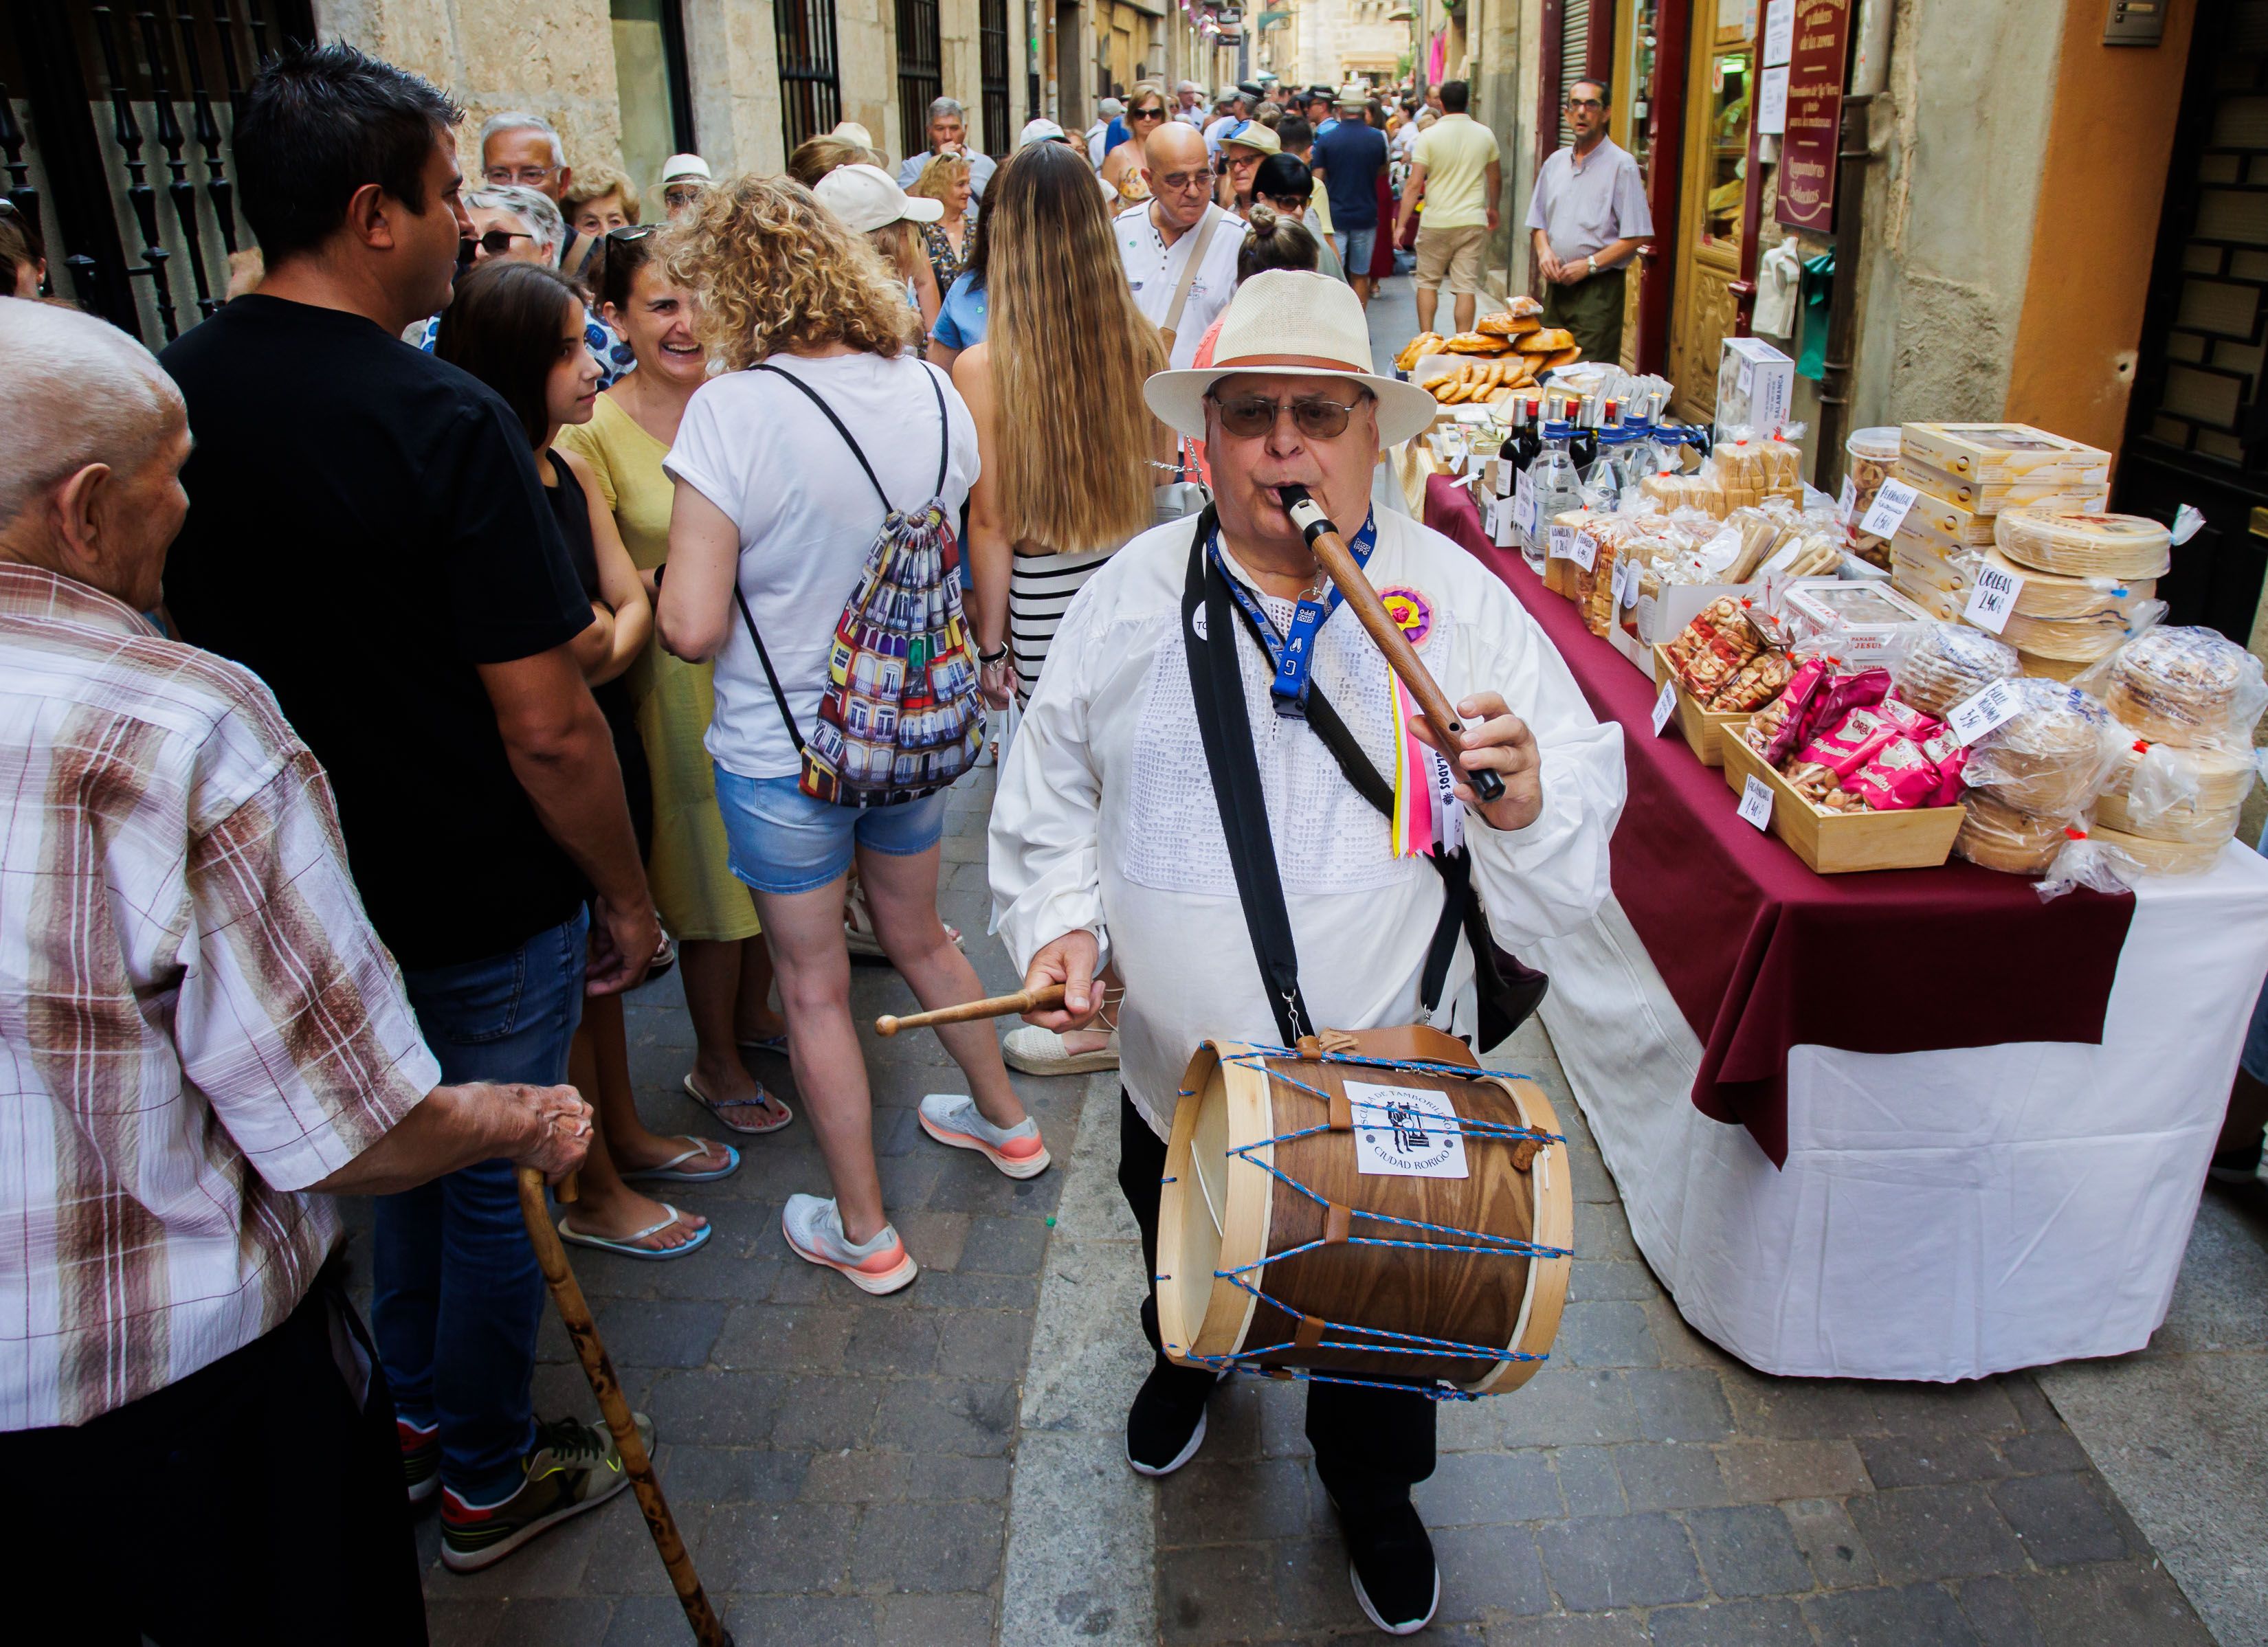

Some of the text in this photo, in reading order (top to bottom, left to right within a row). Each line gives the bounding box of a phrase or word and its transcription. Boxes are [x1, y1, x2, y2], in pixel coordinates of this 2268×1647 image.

[1774, 374, 1784, 419] SALAMANCA
[1354, 544, 1368, 556] EPPO
[1355, 537, 1370, 552] GIOS
[1979, 568, 2012, 595] OBLEAS
[1297, 614, 1314, 624] GIOS
[1299, 608, 1316, 617] EPPO
[1375, 1146, 1450, 1170] CIUDAD RORIGO
